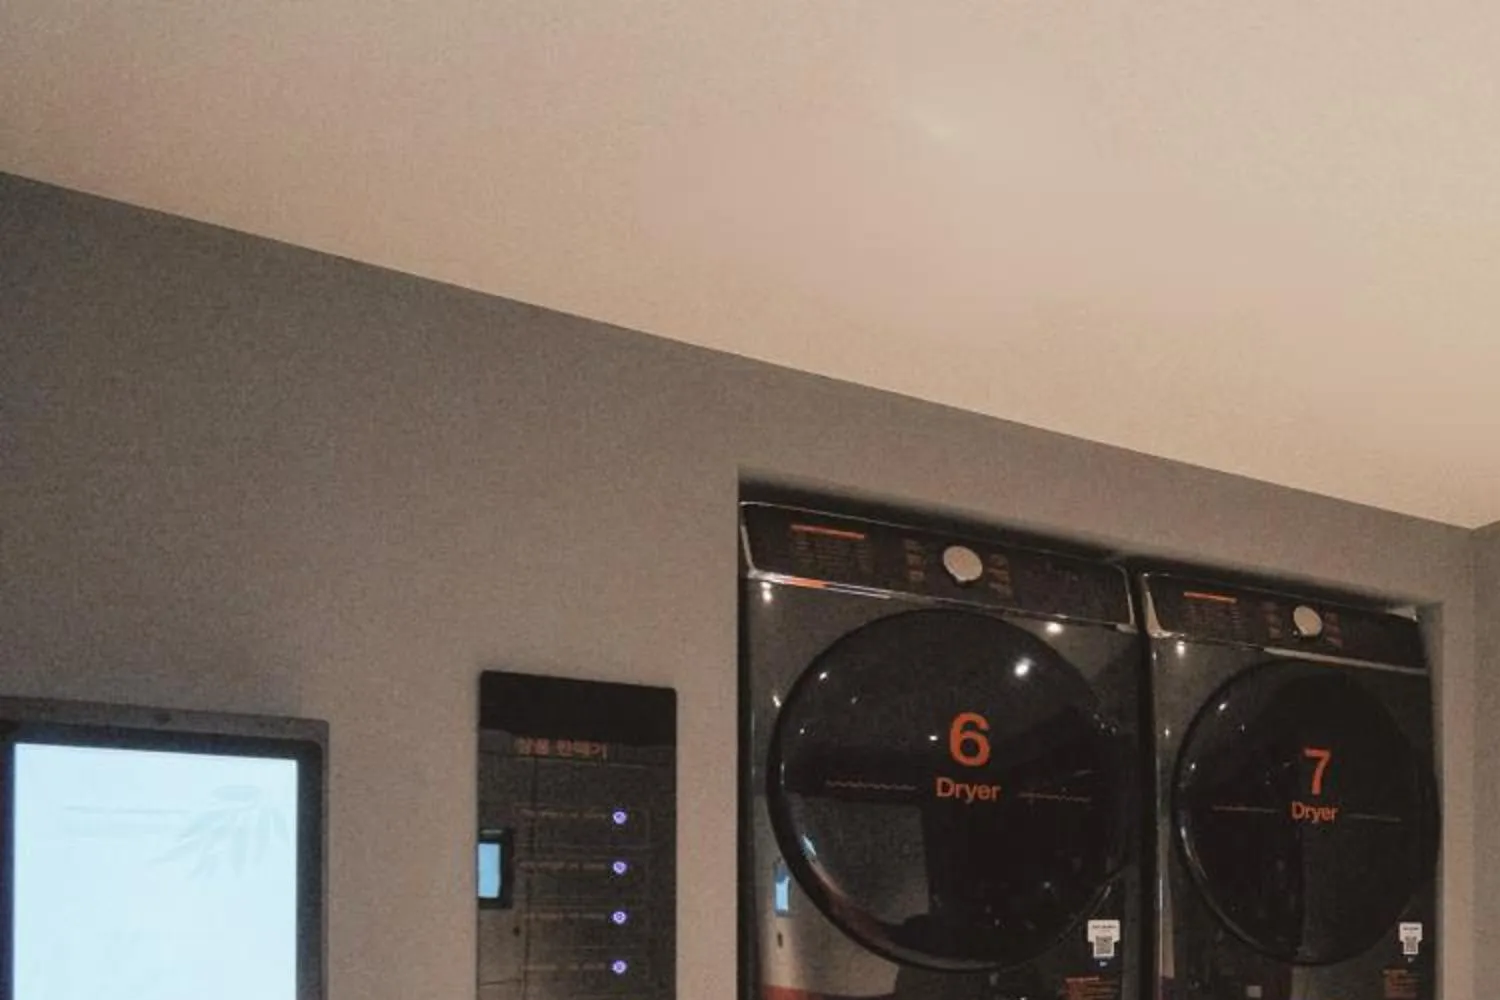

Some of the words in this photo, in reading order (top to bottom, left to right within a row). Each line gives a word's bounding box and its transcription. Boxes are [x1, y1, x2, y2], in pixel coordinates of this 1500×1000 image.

[950, 712, 990, 766] 6
[1304, 747, 1331, 794] 7
[936, 777, 1001, 804] Dryer
[1292, 800, 1338, 823] Dryer
